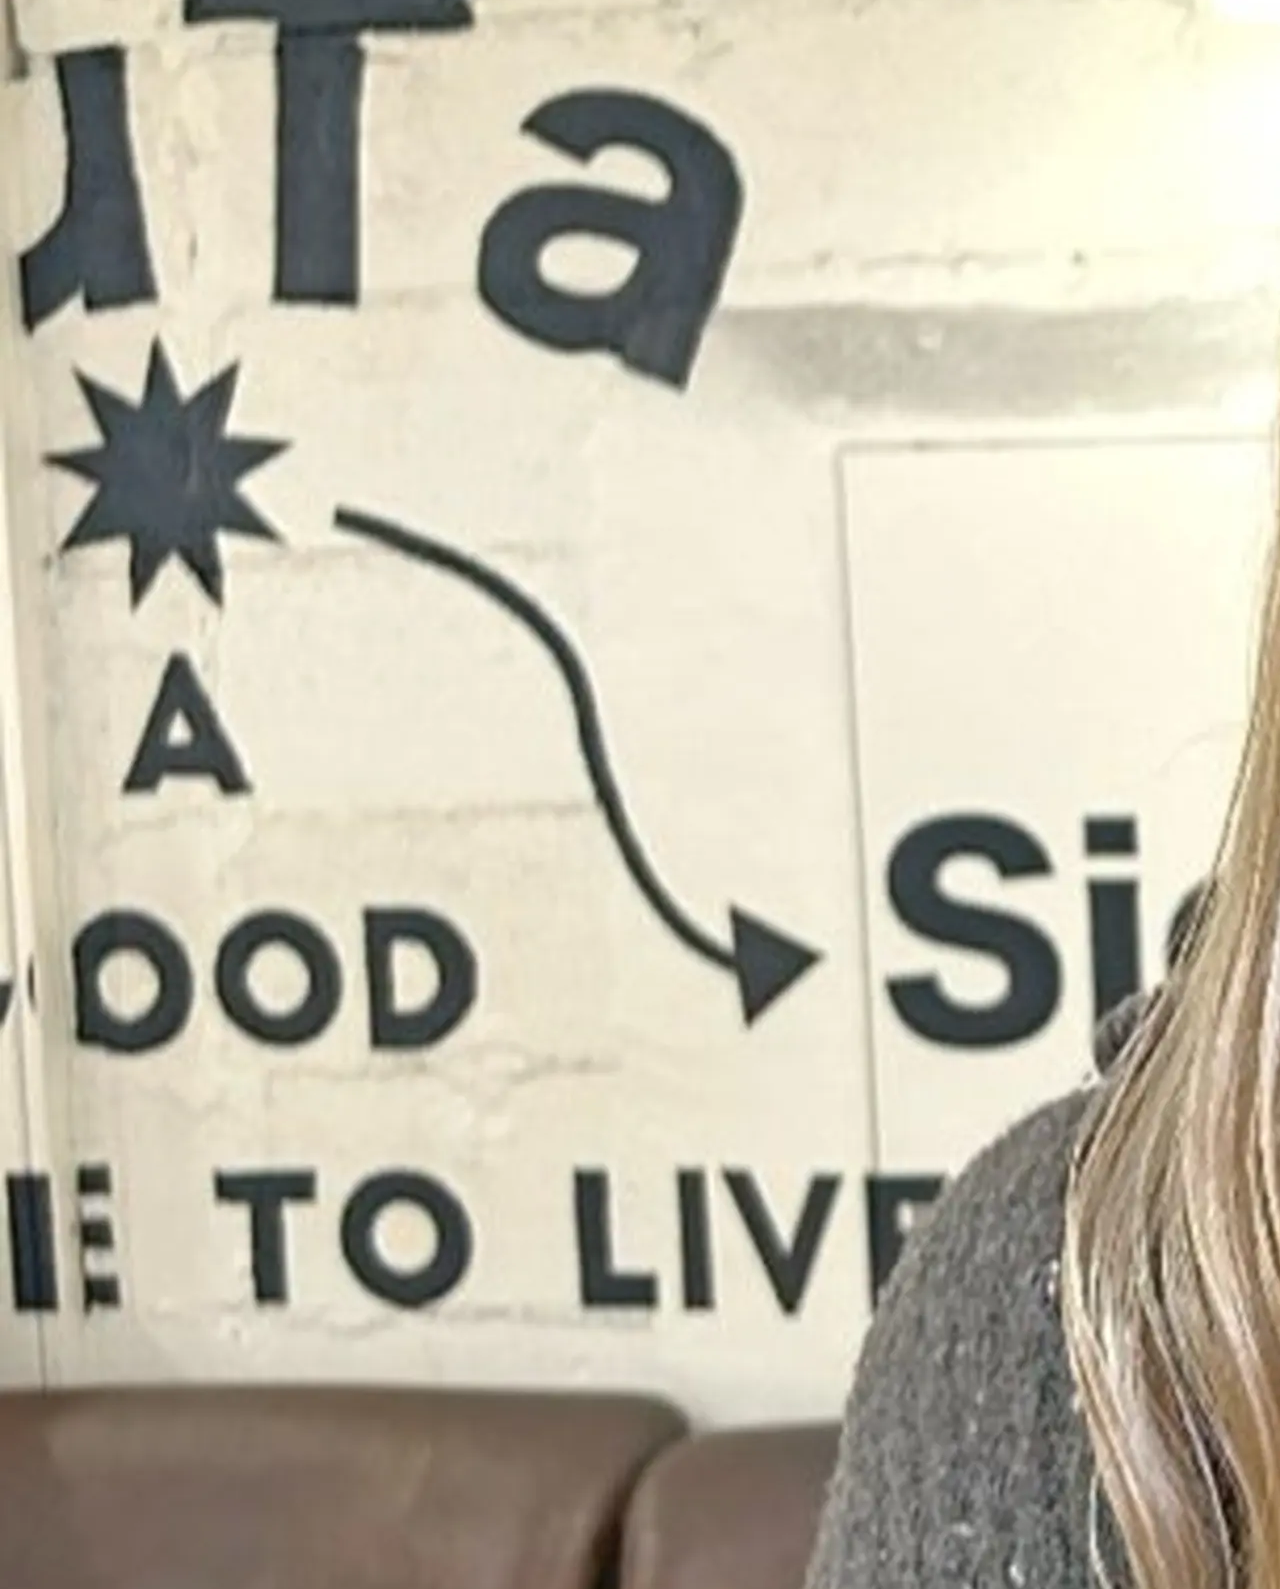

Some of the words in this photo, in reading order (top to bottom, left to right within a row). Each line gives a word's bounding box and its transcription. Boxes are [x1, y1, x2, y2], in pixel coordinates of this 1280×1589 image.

[122, 652, 250, 795] A
[884, 811, 1216, 1051] Si
[213, 1169, 474, 1311] TO
